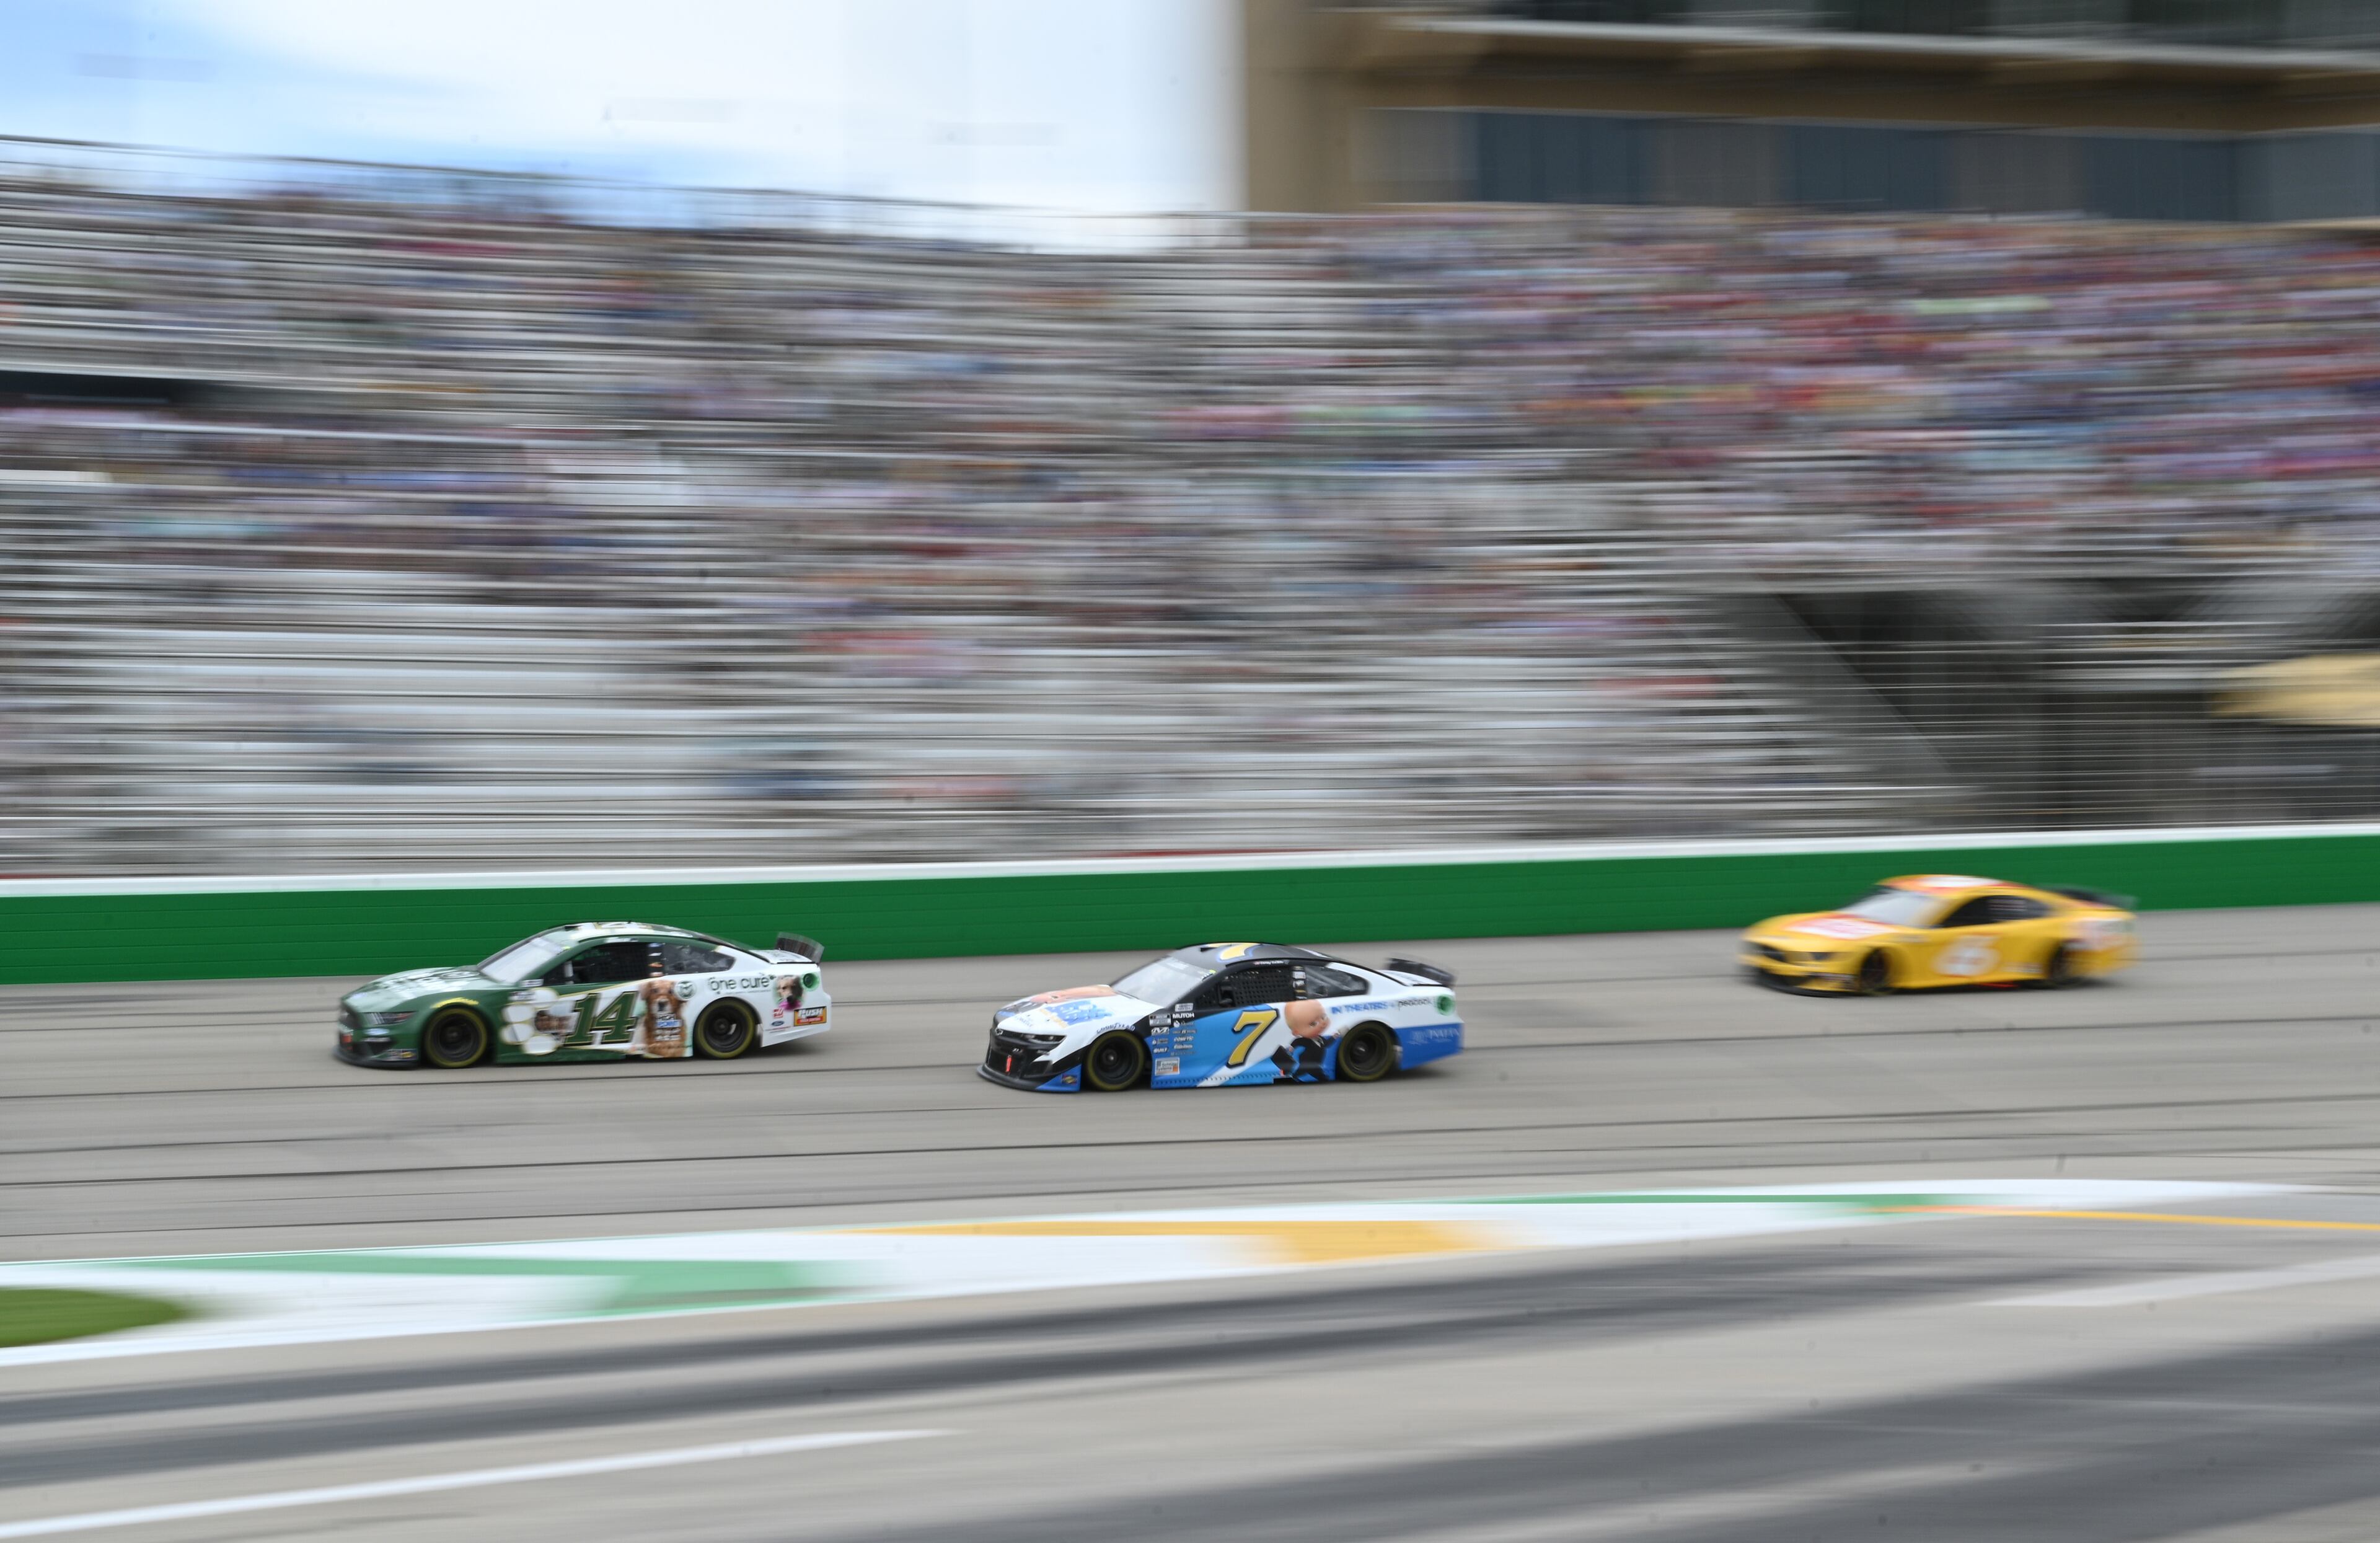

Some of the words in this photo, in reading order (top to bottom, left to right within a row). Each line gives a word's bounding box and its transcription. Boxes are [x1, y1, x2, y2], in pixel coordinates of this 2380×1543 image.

[711, 978, 737, 991] one
[741, 976, 769, 989] cure
[562, 991, 638, 1046] 14
[1345, 1002, 1388, 1012] THEATERS
[1227, 1009, 1280, 1068] 7
